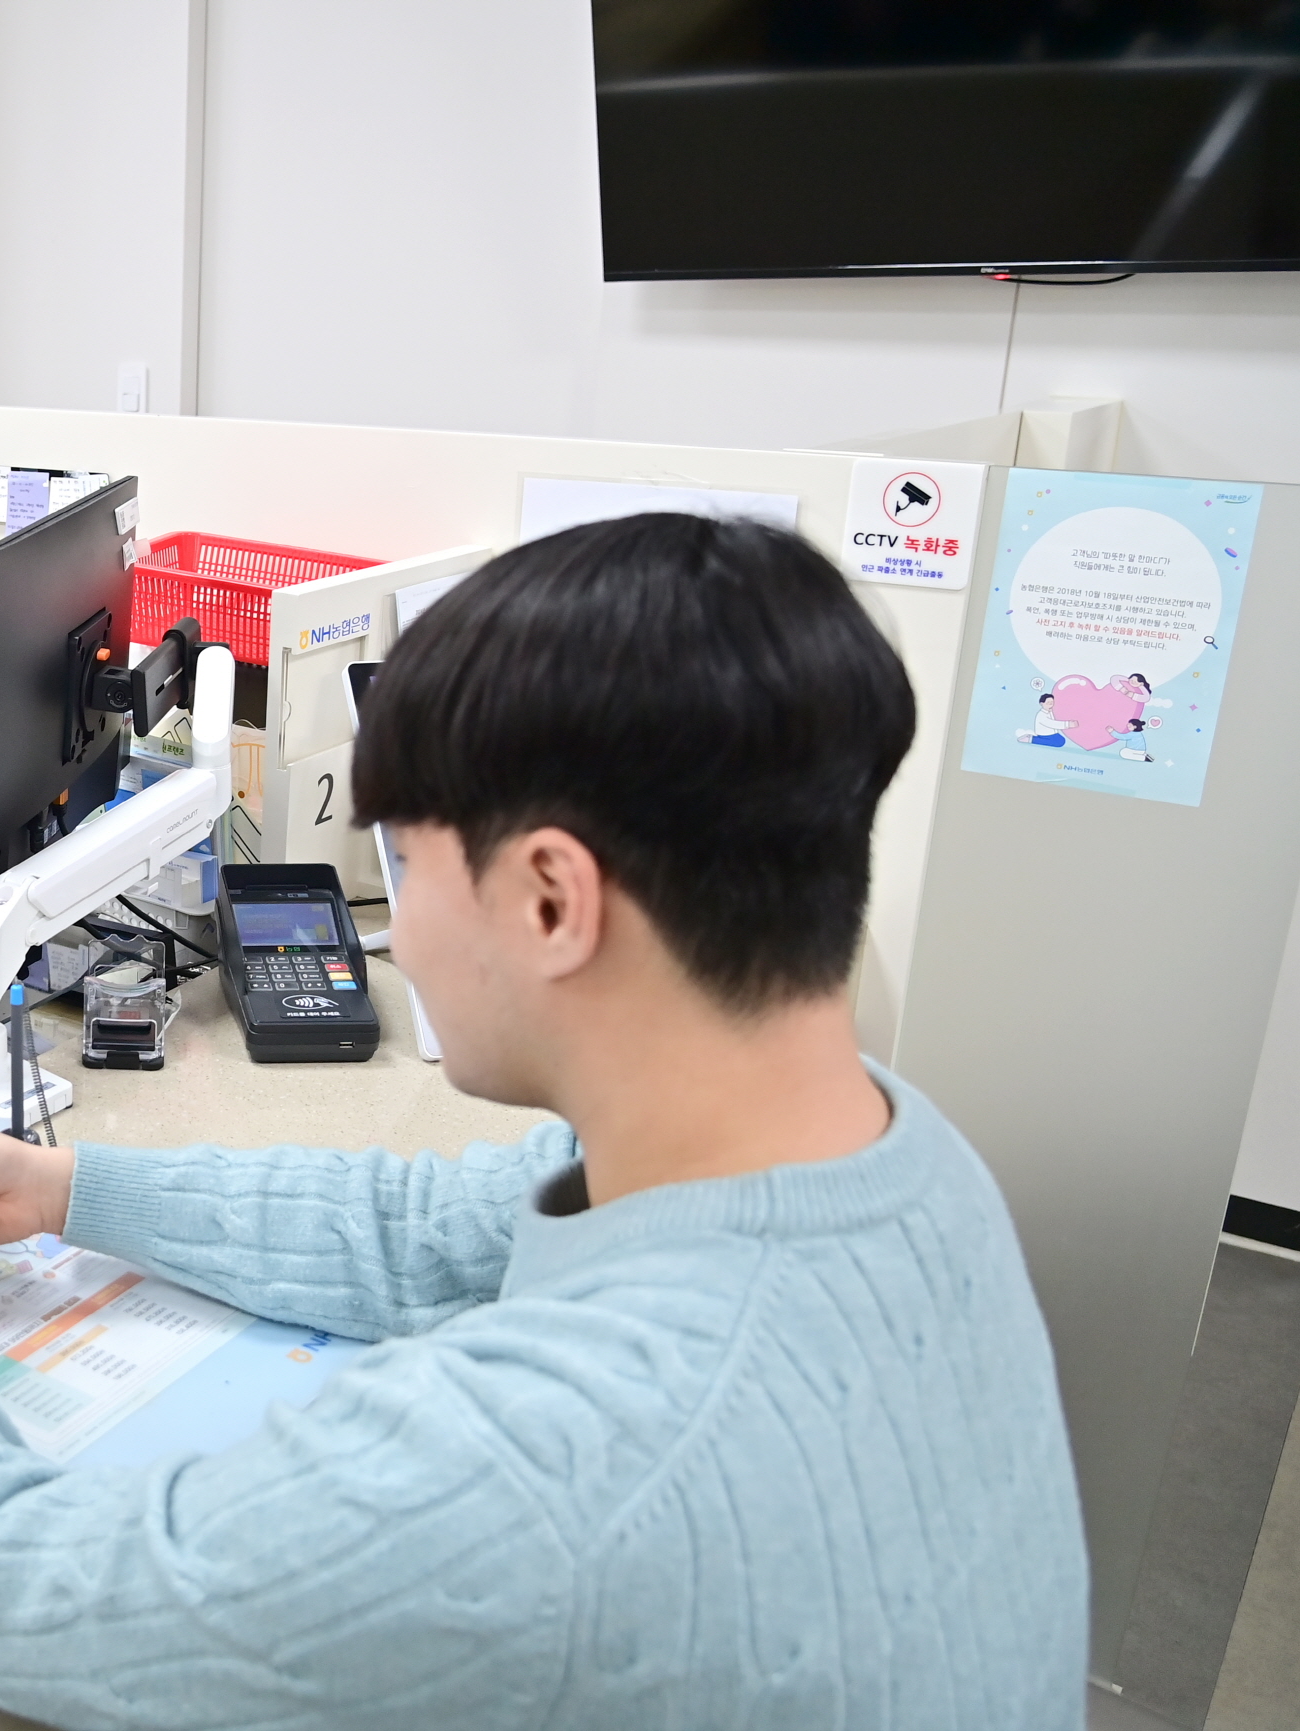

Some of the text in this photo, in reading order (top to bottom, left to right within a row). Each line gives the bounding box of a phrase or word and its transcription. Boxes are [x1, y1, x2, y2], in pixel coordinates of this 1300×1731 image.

[853, 532, 960, 557] CCTV 녹화중
[885, 557, 922, 568] 비상상황 시
[1071, 549, 1100, 559] 고객님의
[1128, 553, 1135, 563] 말
[861, 564, 944, 579] 인근 파출소 연계 긴급출동
[1073, 560, 1167, 577] 직원들에게는 큰 힘이 됩니다.
[1021, 583, 1211, 610] 농협은행은 2018년 10월 18일부터 산업안전보건법에 따라
[1038, 596, 1187, 619] 고객응대근로자보호조치를 시행하고 있습니다.
[1059, 609, 1074, 618] 또는
[1076, 611, 1104, 621] 업무방해
[1106, 614, 1114, 622] 시
[1115, 615, 1137, 624] 상담이
[310, 613, 371, 645] NH농협은행
[1036, 618, 1181, 642] 사전 고지 후 녹취 할 수 있음을 알려드립니다.
[1046, 630, 1167, 651] 배려하는 마음으로 상담 부탁드립니다.
[314, 772, 334, 826] 2
